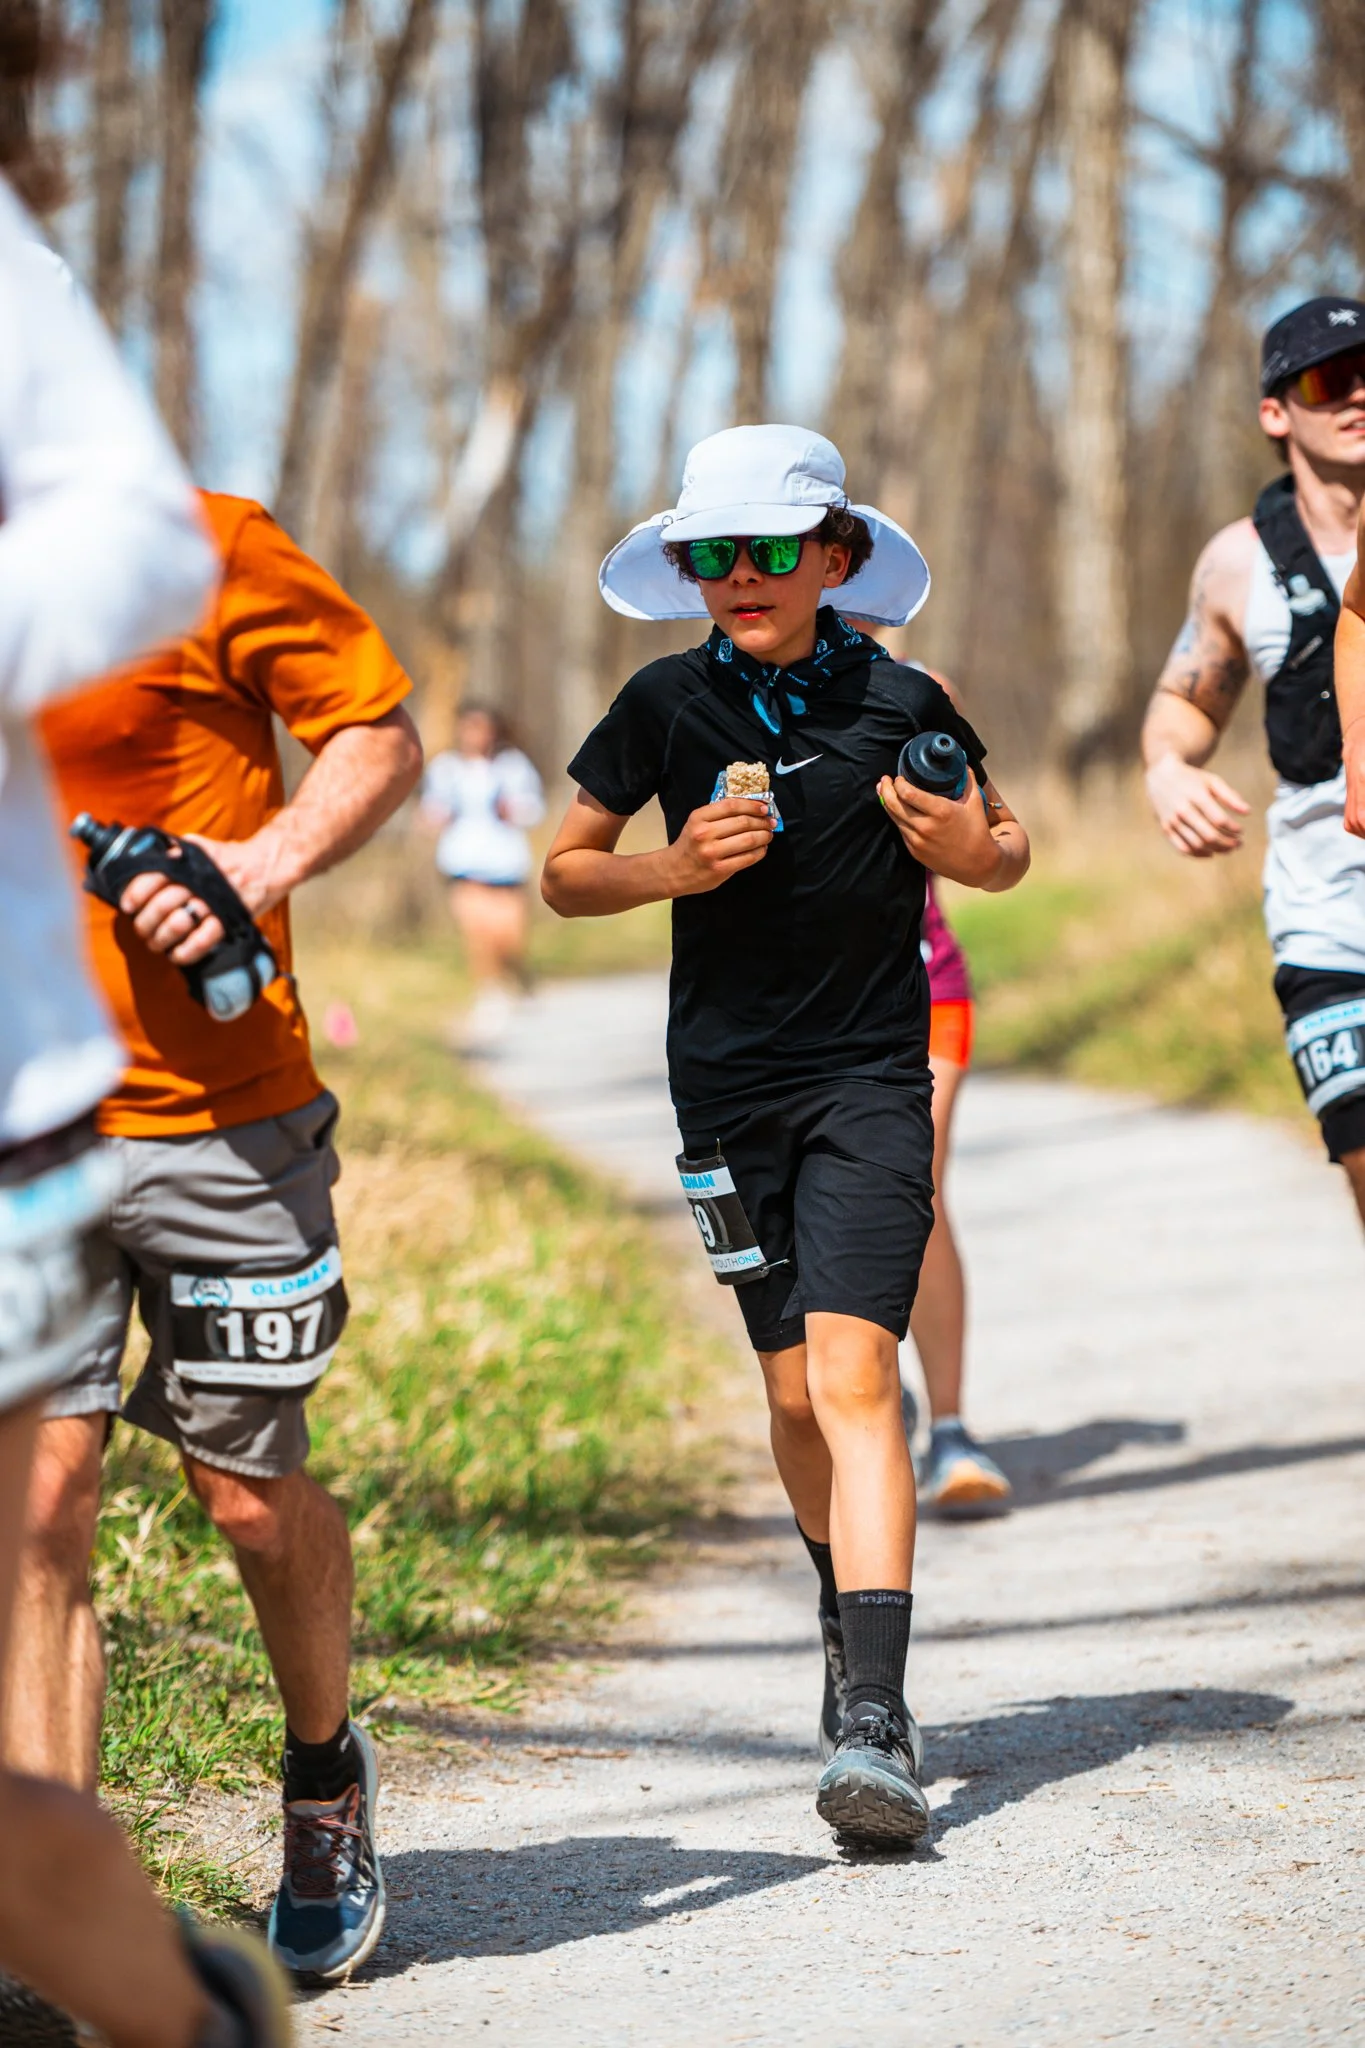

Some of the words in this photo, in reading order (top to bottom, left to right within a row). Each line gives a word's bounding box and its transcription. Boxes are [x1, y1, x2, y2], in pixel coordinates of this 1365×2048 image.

[1297, 1030, 1358, 1088] 164
[252, 1260, 329, 1296] OLDMAN
[216, 1300, 324, 1360] 197
